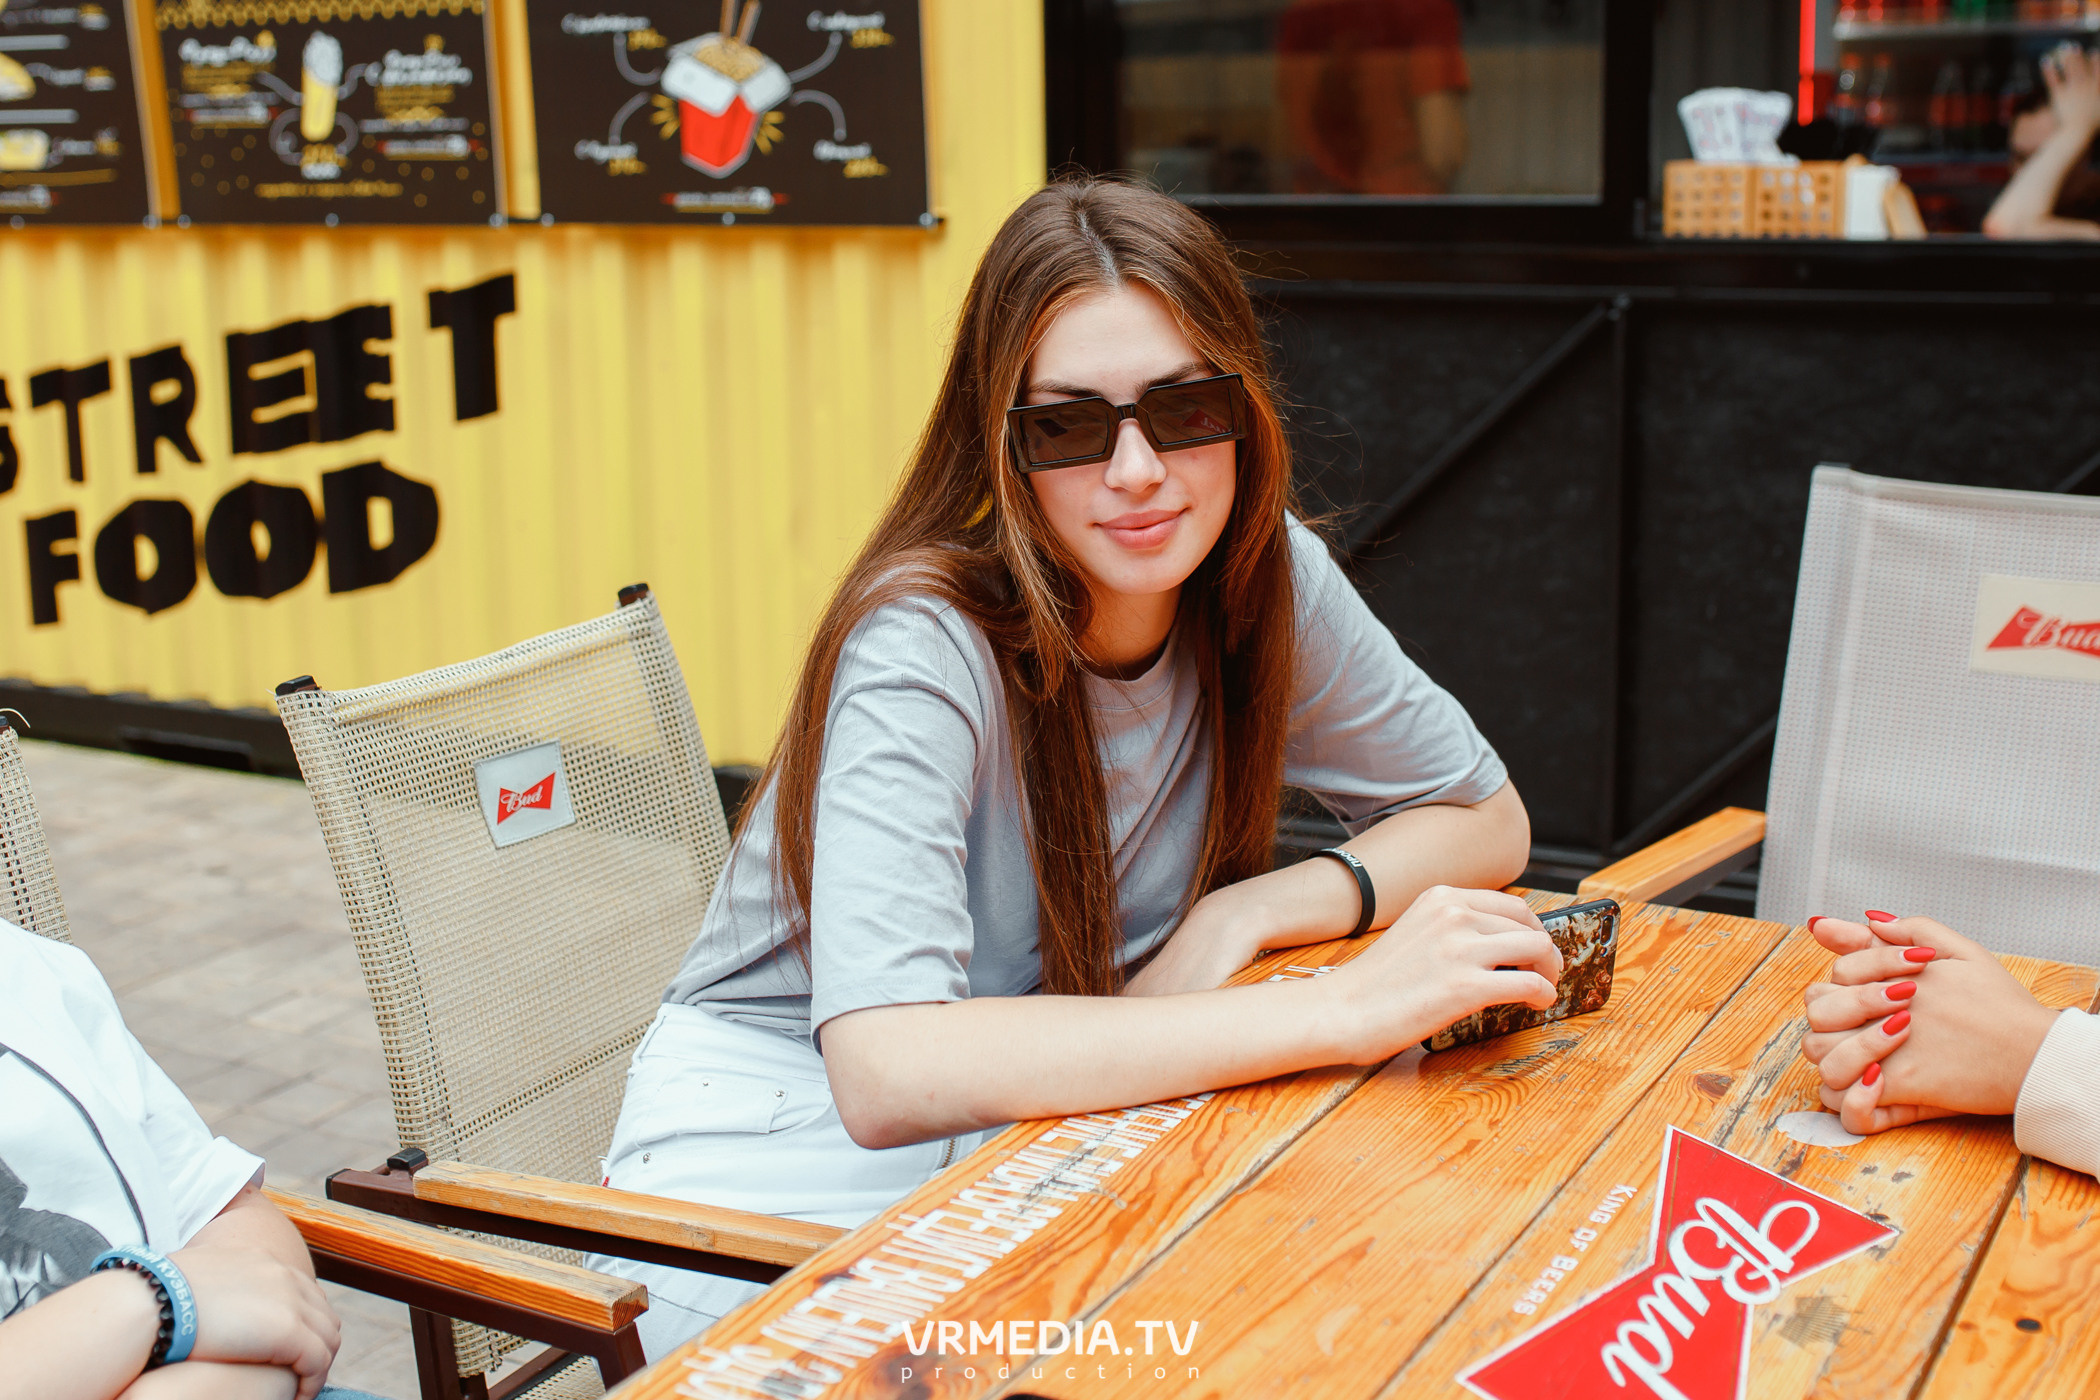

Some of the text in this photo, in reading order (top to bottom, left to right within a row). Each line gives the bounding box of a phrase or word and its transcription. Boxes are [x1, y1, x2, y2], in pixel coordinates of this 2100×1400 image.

[0, 273, 516, 495] TREET
[25, 460, 440, 626] FOOD
[500, 784, 543, 813] Bud
[880, 1188, 1064, 1278] ВРЕДИТ
[1512, 1184, 1638, 1316] KING OF BEERS
[156, 1257, 194, 1337] КУЗБАСС
[760, 1257, 966, 1369] ВАШЕМУ
[1601, 1197, 1820, 1400] Bud
